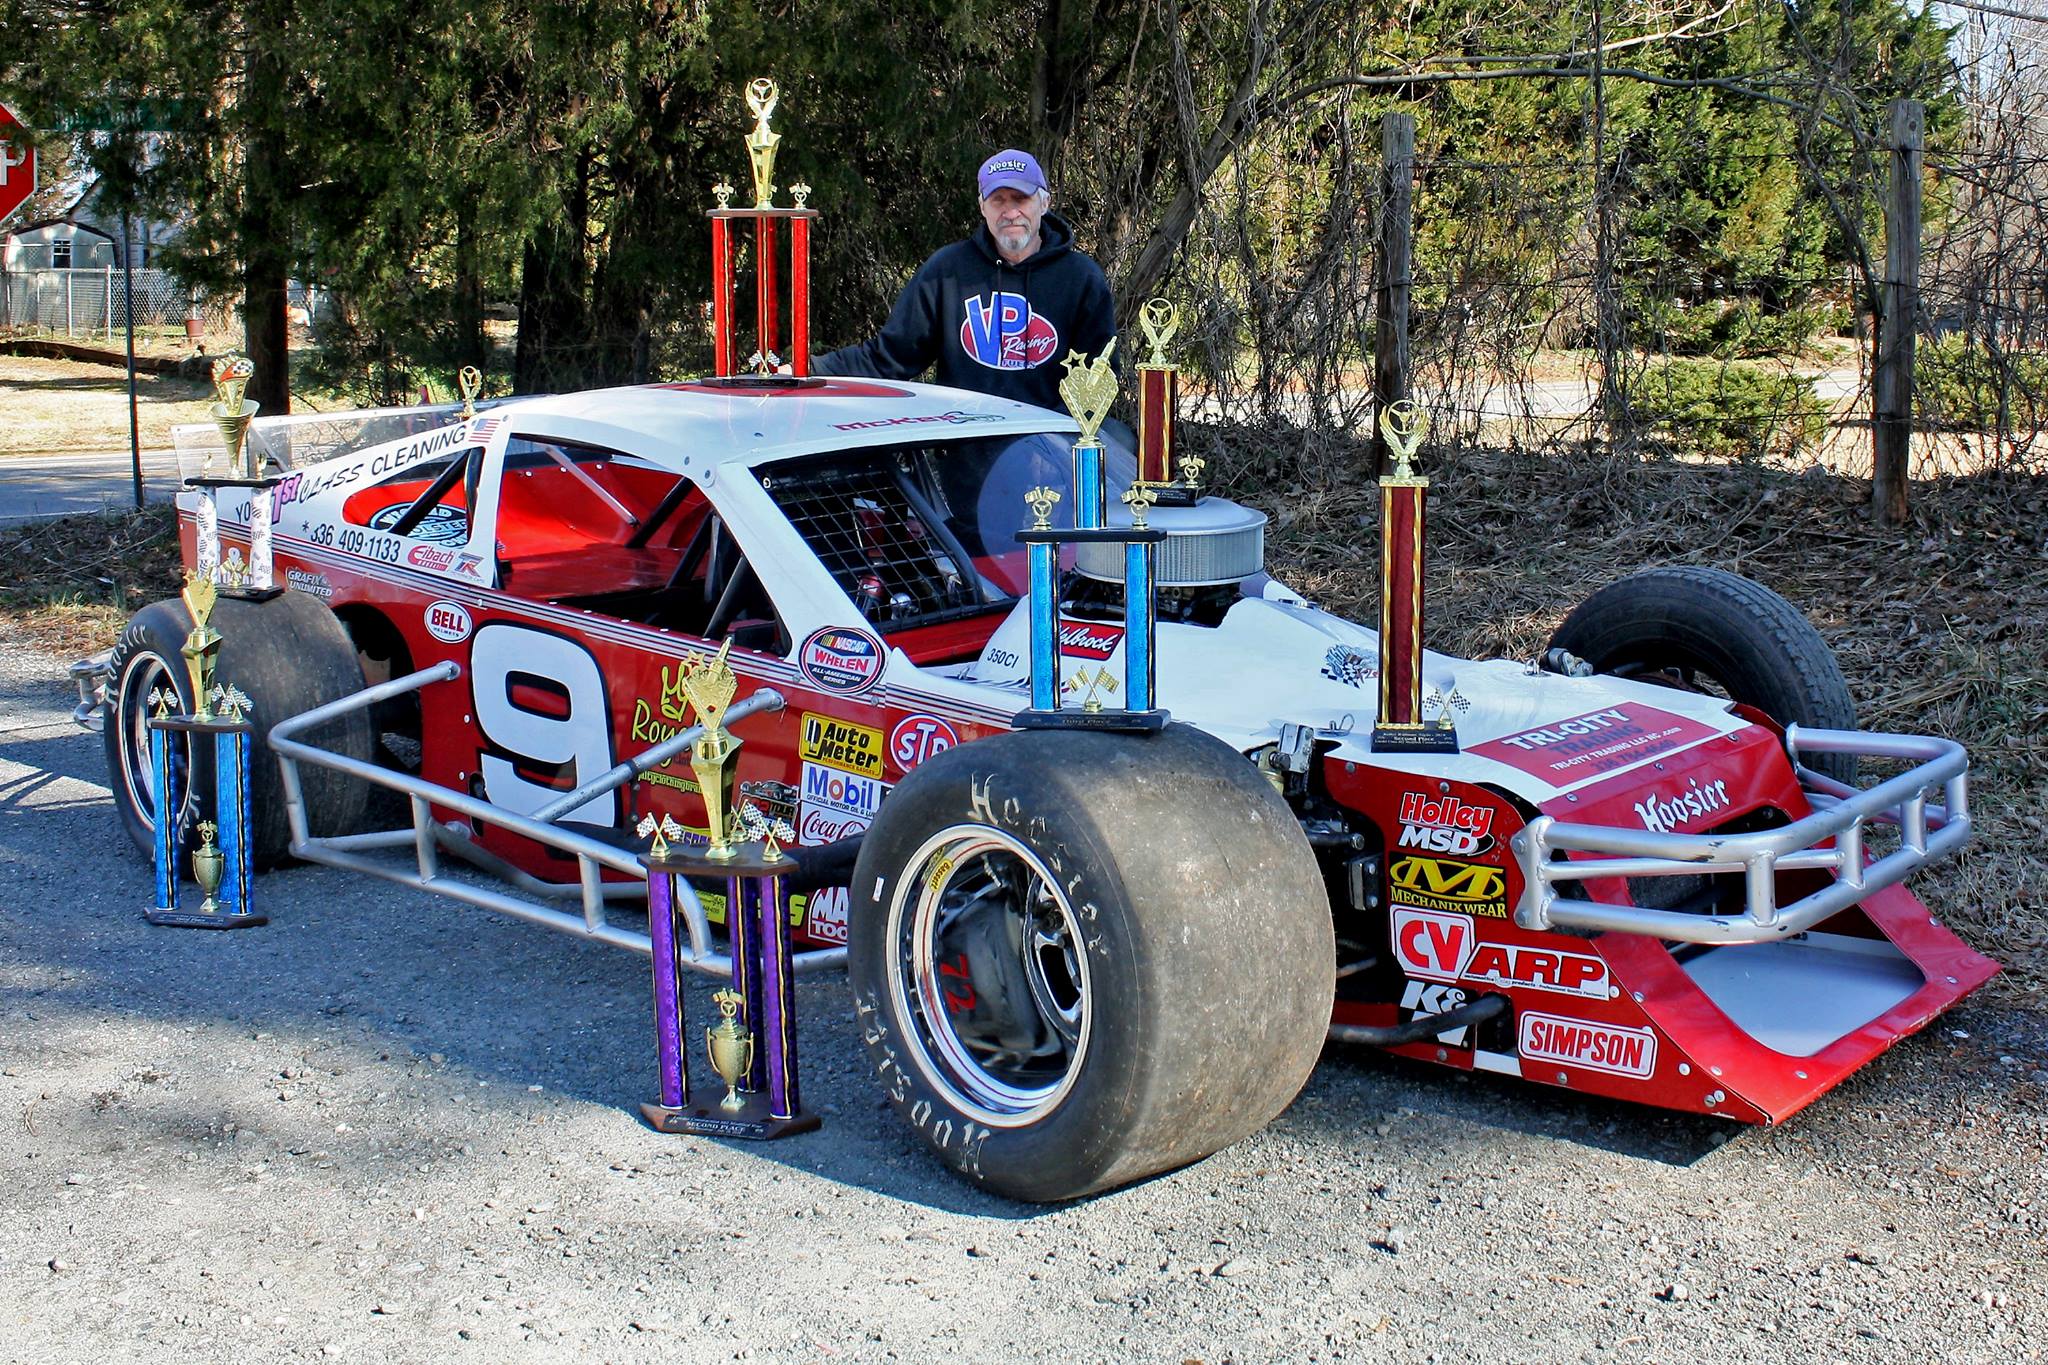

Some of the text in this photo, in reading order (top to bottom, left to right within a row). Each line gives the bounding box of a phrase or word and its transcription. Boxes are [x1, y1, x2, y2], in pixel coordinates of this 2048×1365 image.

[988, 159, 1027, 175] Hoosier
[964, 291, 1031, 368] VP
[1003, 333, 1056, 358] Racing
[299, 463, 365, 503] CLASS
[371, 425, 466, 476] CLEANING
[407, 545, 455, 569] Eibach
[431, 608, 465, 633] BELL
[834, 636, 870, 654] NASCAR
[812, 667, 862, 682] ALL-AMERICAN
[814, 648, 869, 673] WHELEN
[822, 675, 847, 685] SERIES
[470, 623, 617, 828] 9
[823, 723, 870, 749] Auto
[1502, 709, 1632, 751] TRI-CITY
[819, 739, 879, 769] Meter
[898, 723, 949, 766] STP
[1550, 754, 1592, 771] TRI-CITY
[1590, 743, 1632, 760] TRADING
[807, 766, 874, 810] Mobil
[806, 794, 829, 805] OFFICIAL
[830, 801, 851, 811] MOTOR
[850, 805, 860, 814] OIL
[1400, 792, 1495, 837] Holley
[1634, 777, 1731, 834] Hoosier
[1398, 825, 1481, 856] MSD
[1390, 885, 1508, 919] MECHANIX WEAR
[1400, 919, 1465, 973] CV
[1468, 945, 1606, 990] ARP
[1529, 1020, 1645, 1070] SIMPSON
[686, 1120, 719, 1130] SECOND
